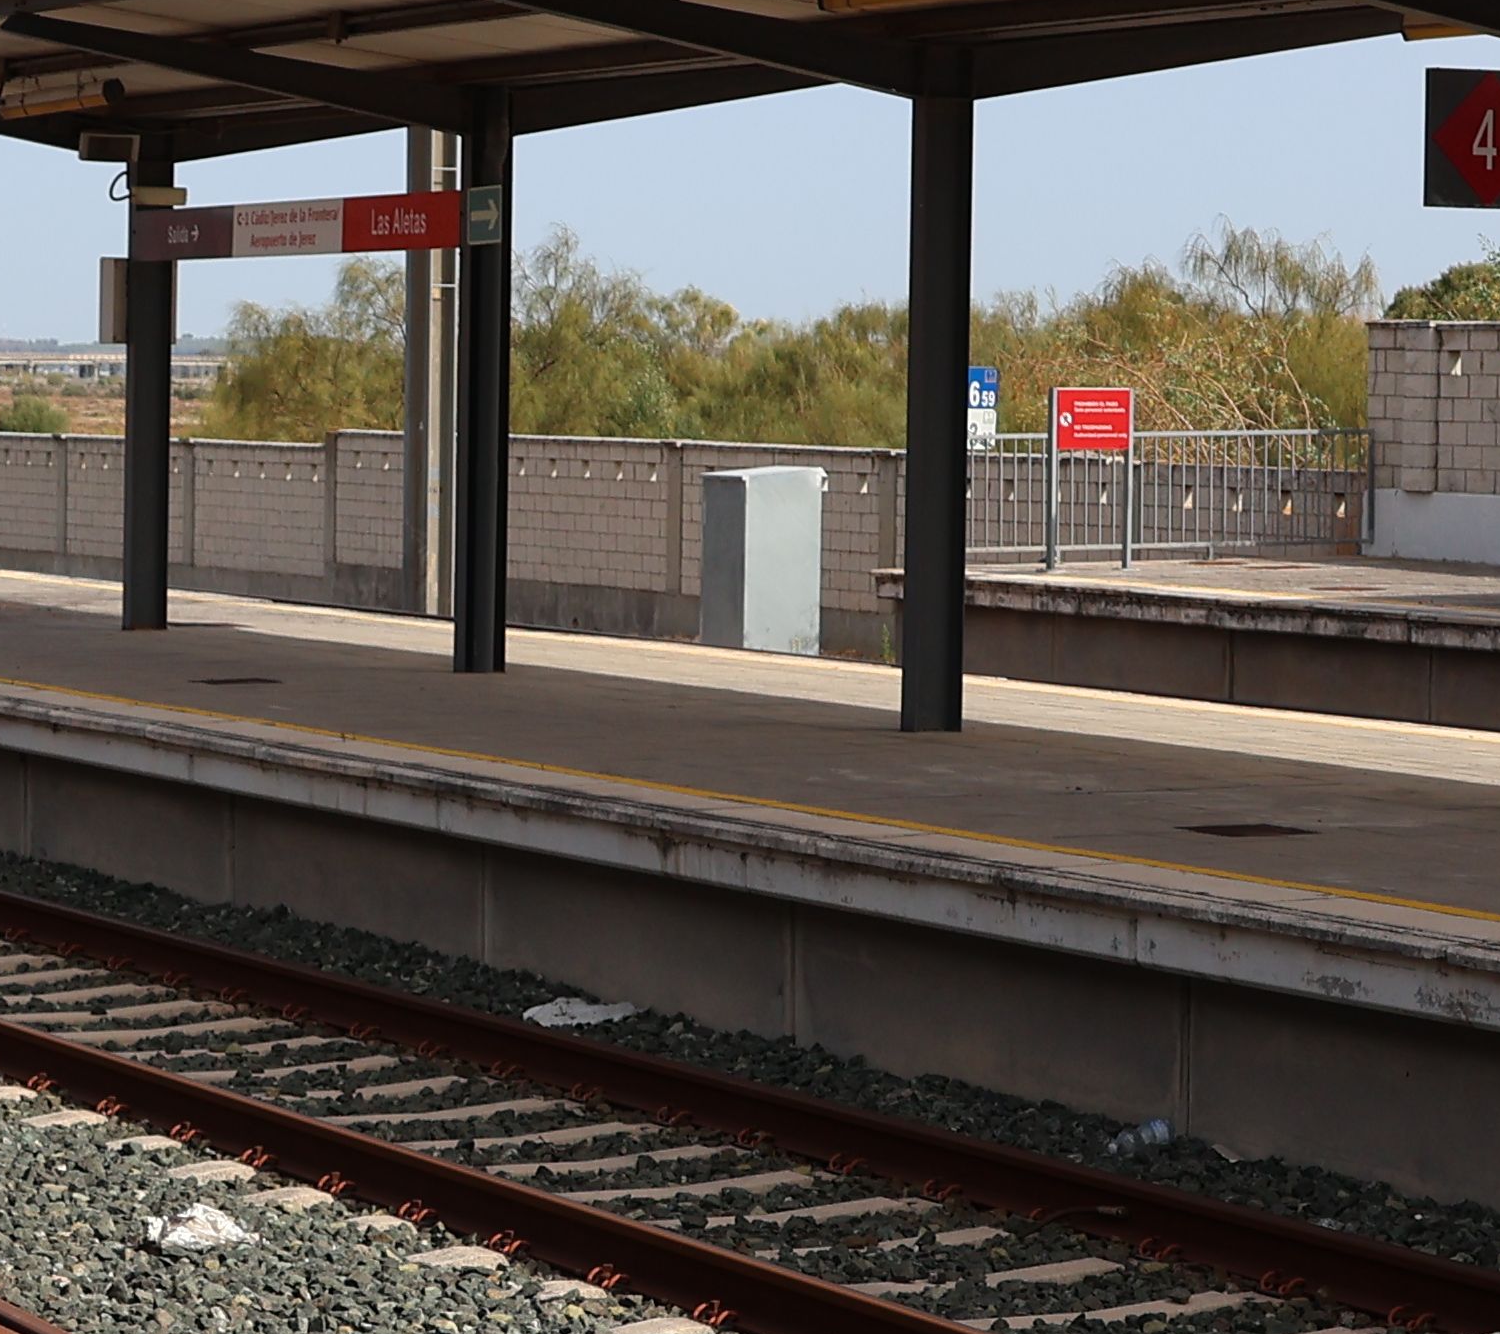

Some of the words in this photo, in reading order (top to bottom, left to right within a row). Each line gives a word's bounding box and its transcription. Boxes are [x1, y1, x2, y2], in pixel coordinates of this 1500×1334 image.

[1472, 109, 1497, 170] 4
[371, 208, 390, 236] Las
[393, 207, 427, 235] Aletas
